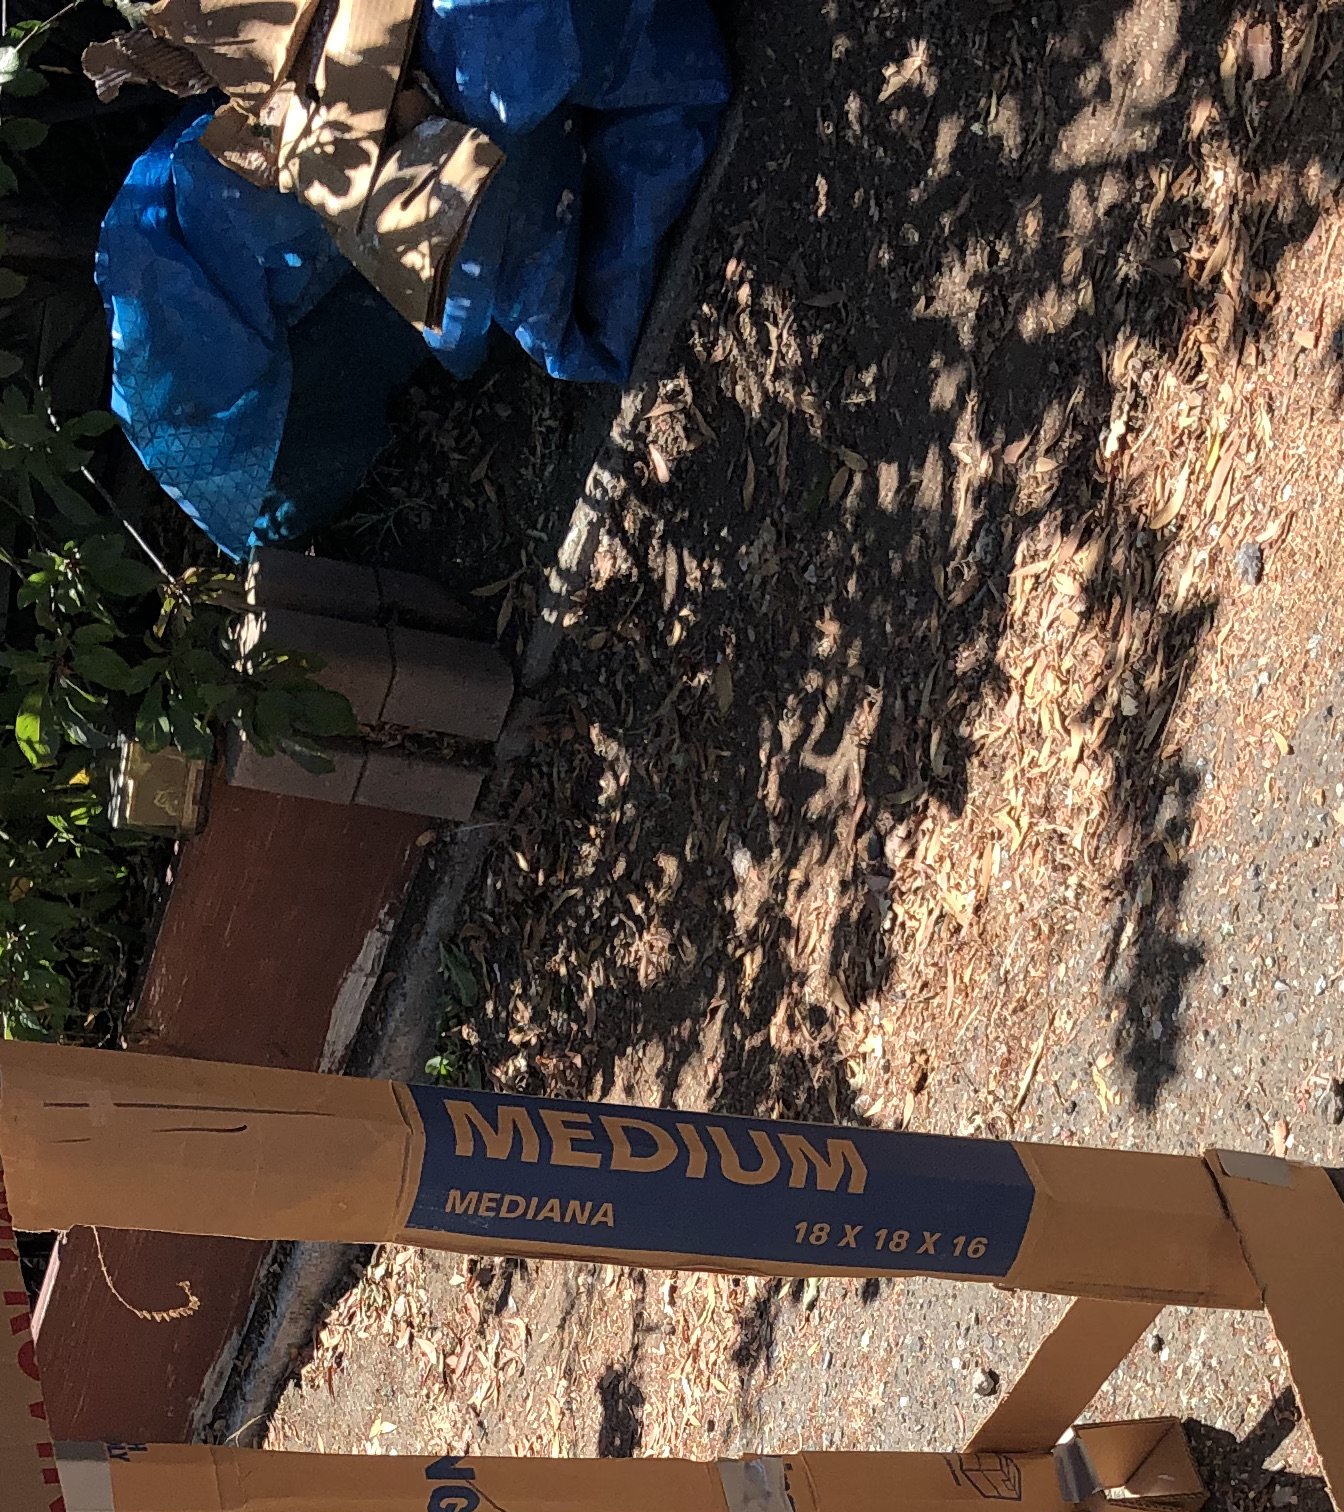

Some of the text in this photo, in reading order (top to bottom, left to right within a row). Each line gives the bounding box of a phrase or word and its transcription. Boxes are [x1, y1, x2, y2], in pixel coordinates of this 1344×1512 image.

[444, 1099, 868, 1195] MEDIUM
[445, 1189, 615, 1228] MEDIANA
[793, 1220, 989, 1260] 18 X 18 X 16
